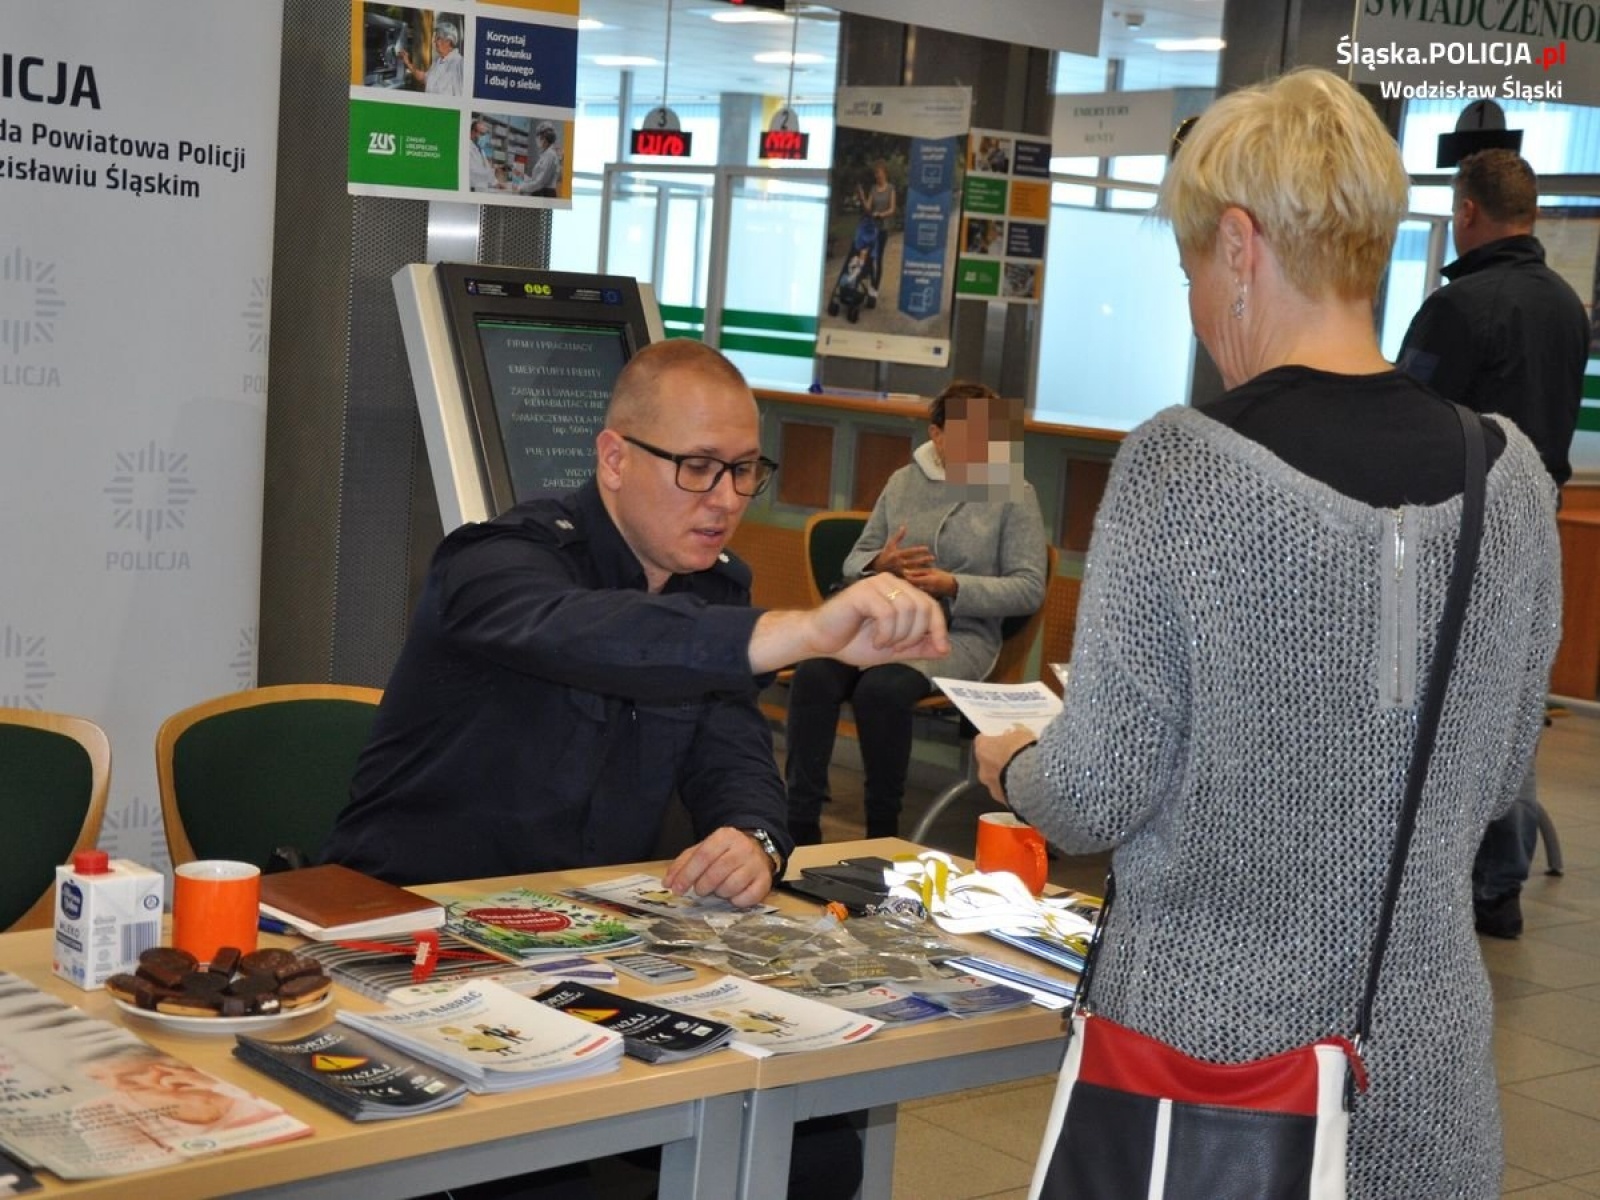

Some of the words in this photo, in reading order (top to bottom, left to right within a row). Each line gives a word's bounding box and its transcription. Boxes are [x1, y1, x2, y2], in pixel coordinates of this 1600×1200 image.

[486, 30, 526, 47] Korzystaj
[492, 47, 532, 61] rachunku
[485, 60, 534, 77] bankowego
[489, 75, 508, 89] dbaj
[509, 79, 516, 88] o
[516, 78, 541, 91] siebie
[657, 108, 668, 129] 3
[779, 109, 789, 130] 2
[1474, 102, 1484, 129] 1
[32, 122, 169, 160] Powiatowa
[178, 140, 246, 173] Policji
[367, 131, 396, 155] ZUS
[106, 163, 200, 199] Śląskim
[2, 365, 61, 388] LICJA
[105, 551, 192, 572] POLICJA
